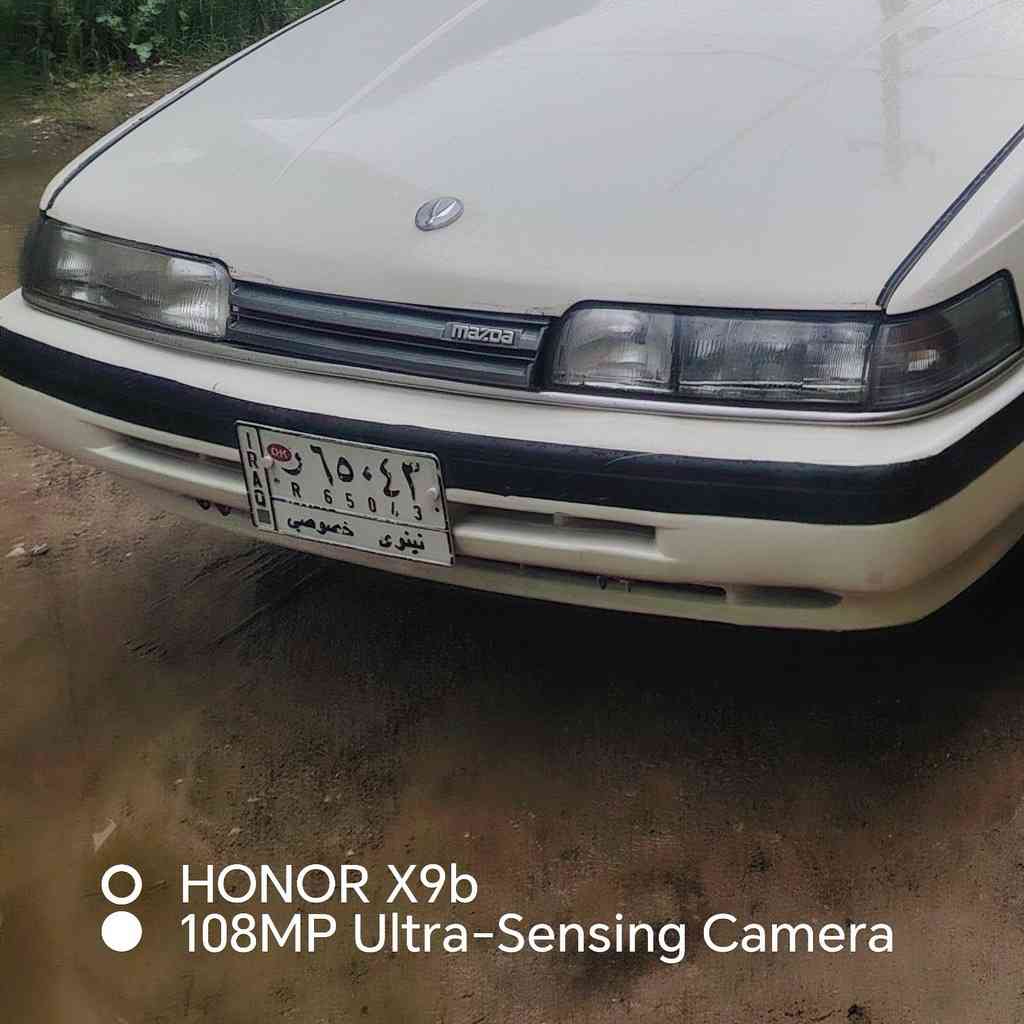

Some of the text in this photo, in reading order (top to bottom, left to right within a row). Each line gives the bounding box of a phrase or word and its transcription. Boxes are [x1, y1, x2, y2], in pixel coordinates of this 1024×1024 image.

[451, 324, 515, 345] mazda
[246, 431, 266, 507] IRAQ
[378, 530, 425, 554] نينوى
